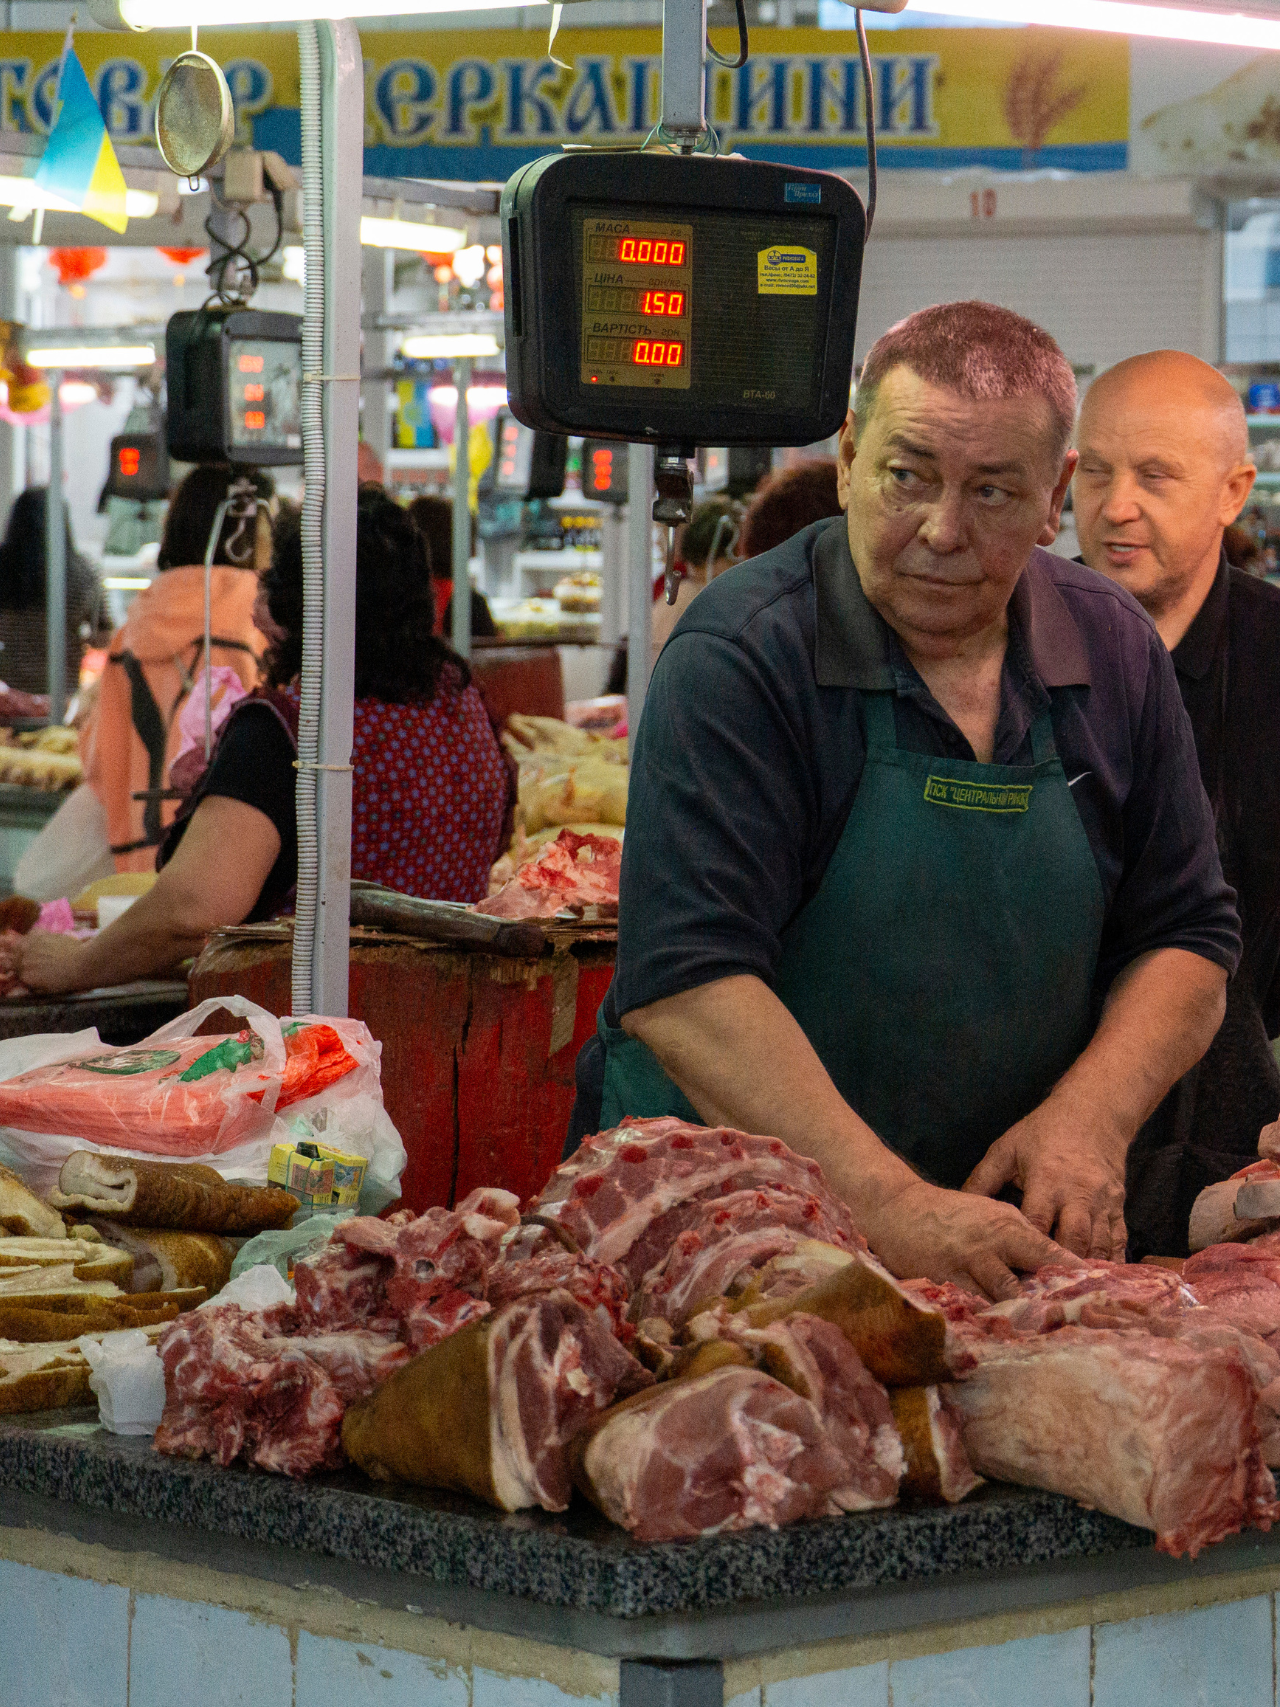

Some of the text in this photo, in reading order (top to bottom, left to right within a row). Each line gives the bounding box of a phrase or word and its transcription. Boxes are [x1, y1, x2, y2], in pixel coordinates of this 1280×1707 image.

[970, 187, 997, 217] 10
[595, 223, 630, 234] МАСА
[620, 239, 685, 265] 0.000
[594, 273, 624, 285] ЦІНА
[642, 291, 683, 315] 1.50
[592, 322, 652, 335] ВАРТІСТЬ
[633, 341, 683, 367] 0.00
